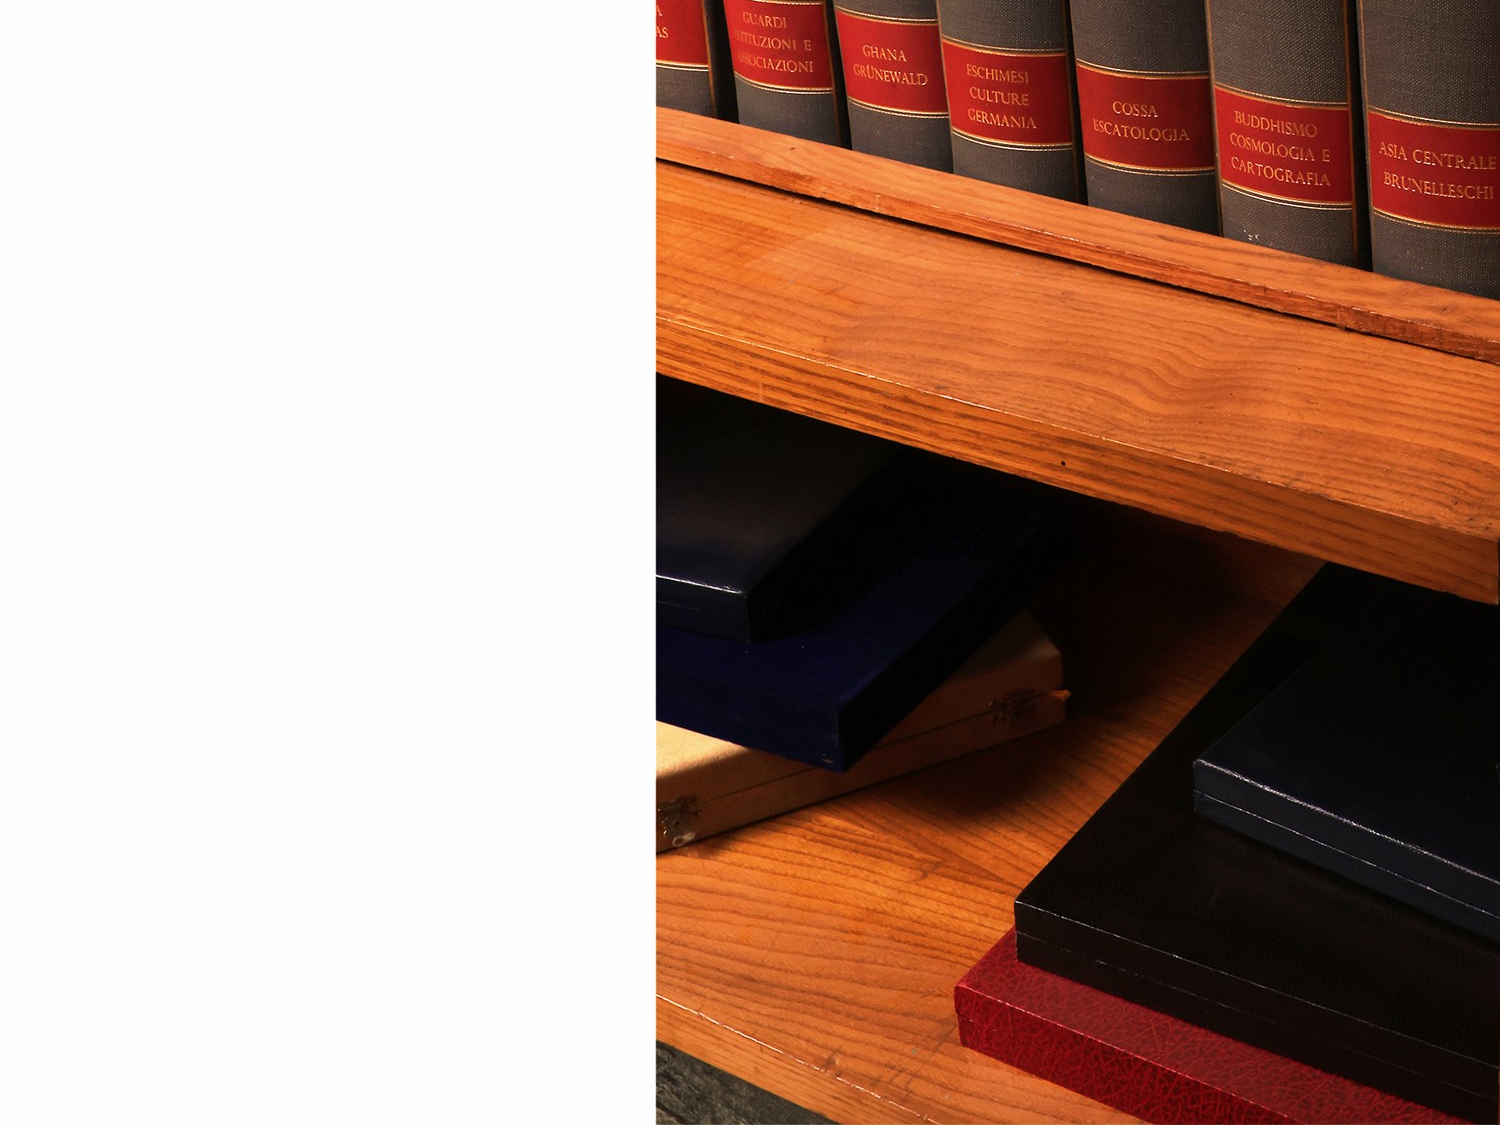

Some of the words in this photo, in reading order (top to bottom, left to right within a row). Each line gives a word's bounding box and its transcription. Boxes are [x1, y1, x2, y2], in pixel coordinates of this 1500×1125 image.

[742, 11, 787, 29] GUARDI
[735, 29, 797, 51] STITUZIONI
[803, 39, 812, 52] E
[862, 44, 907, 63] GHANA
[853, 64, 928, 87] GRÜNEWALD
[966, 63, 1029, 84] ESCHIMESI
[969, 86, 1029, 106] CULTURE
[967, 108, 1037, 130] GERMANIA
[1112, 100, 1159, 118] COSSA
[1093, 119, 1190, 142] ESCATOLOGIA
[1234, 110, 1318, 138] BUDDHISMO
[1229, 132, 1315, 162] COSMOLOGIA
[1321, 149, 1330, 163] E
[1379, 140, 1408, 161] ASIA
[1412, 148, 1498, 171] CENTRALE
[1231, 156, 1331, 187] CARTOGRAFIA
[1383, 172, 1495, 201] BRUNELLESCHI
